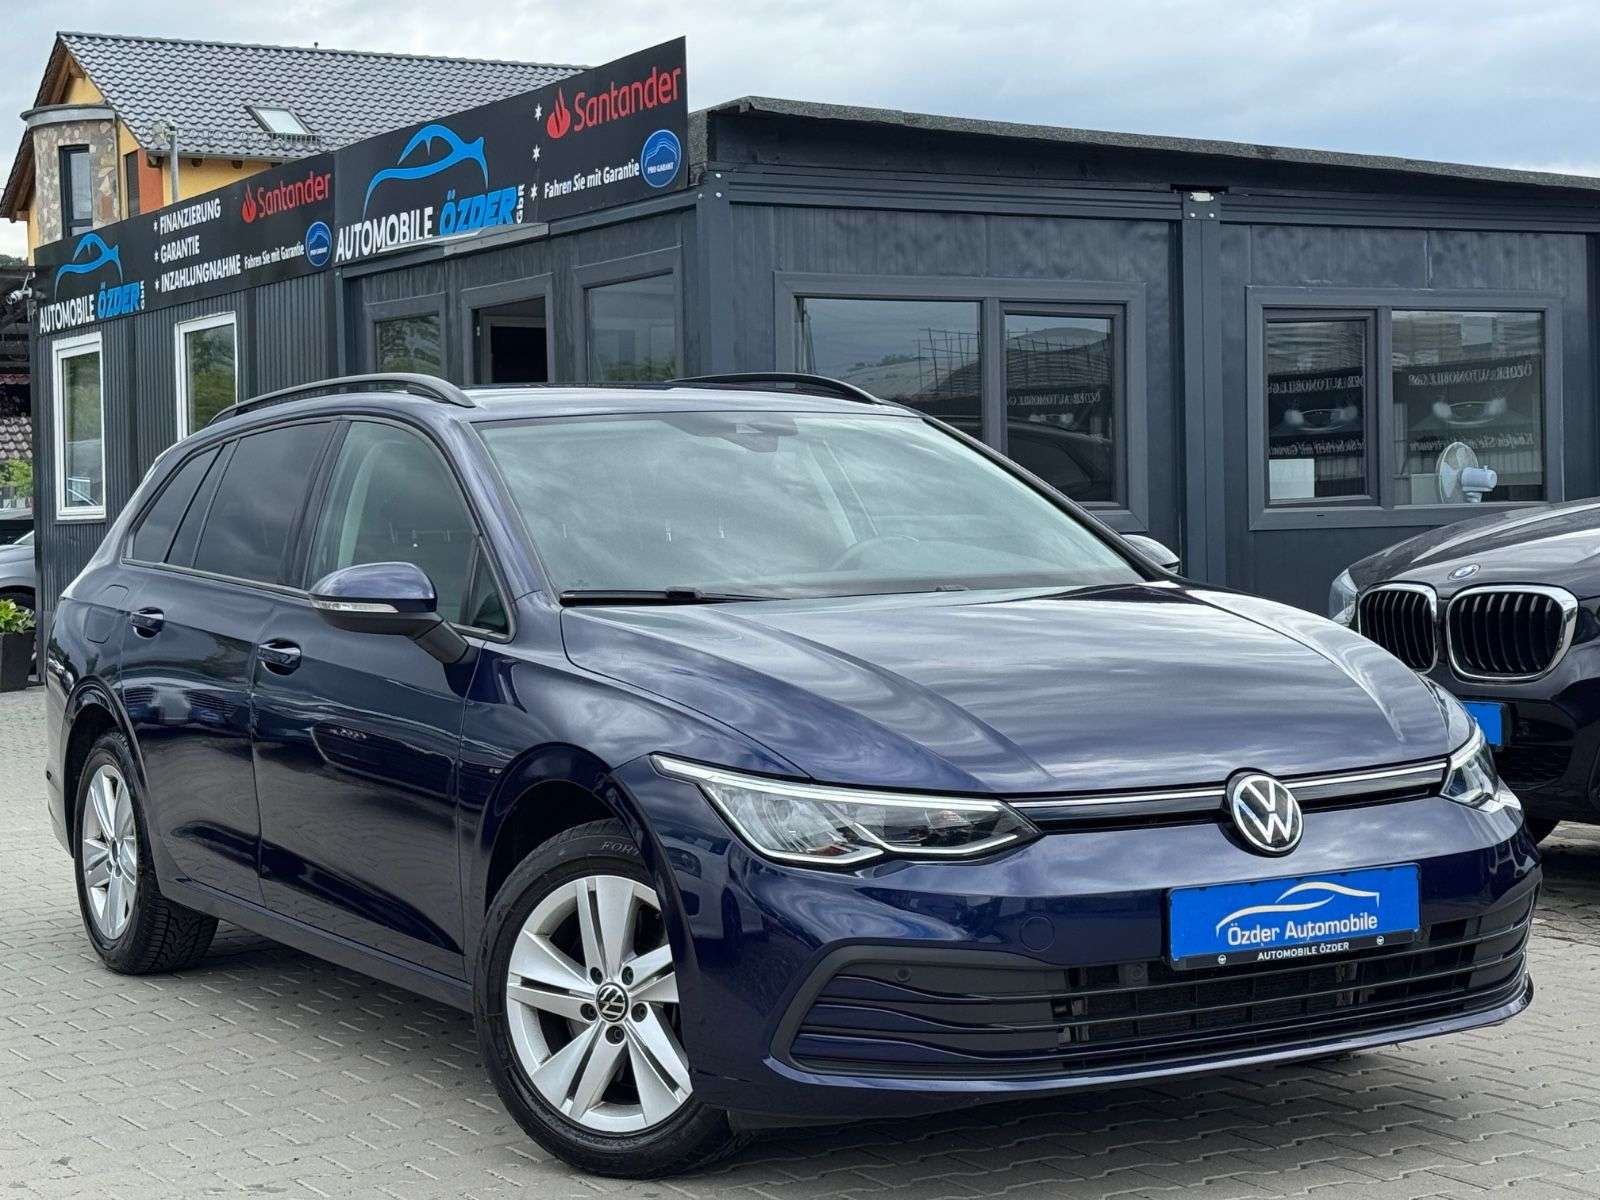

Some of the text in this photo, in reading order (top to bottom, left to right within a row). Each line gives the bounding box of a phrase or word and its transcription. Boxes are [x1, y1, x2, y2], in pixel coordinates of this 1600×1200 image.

[574, 66, 681, 132] Santander
[257, 170, 331, 218] Santander
[544, 158, 640, 199] Fahren Sie mit Garantie
[160, 198, 221, 235] FINANZIERUNG
[335, 206, 434, 263] AUTOMOBILE
[438, 187, 517, 237] ÖZDER
[160, 235, 200, 264] GARANTIE
[244, 254, 262, 270] Fahren
[262, 250, 271, 265] Sie
[281, 240, 305, 260] Garantie
[161, 254, 241, 293] INZAHLUNGNAHME
[40, 294, 95, 334] AUTOMOBILE
[98, 281, 140, 319] ÖZDER
[1227, 912, 1378, 946] Özder Automobile
[1257, 941, 1350, 961] AUTOMOBILE ÖZDER
